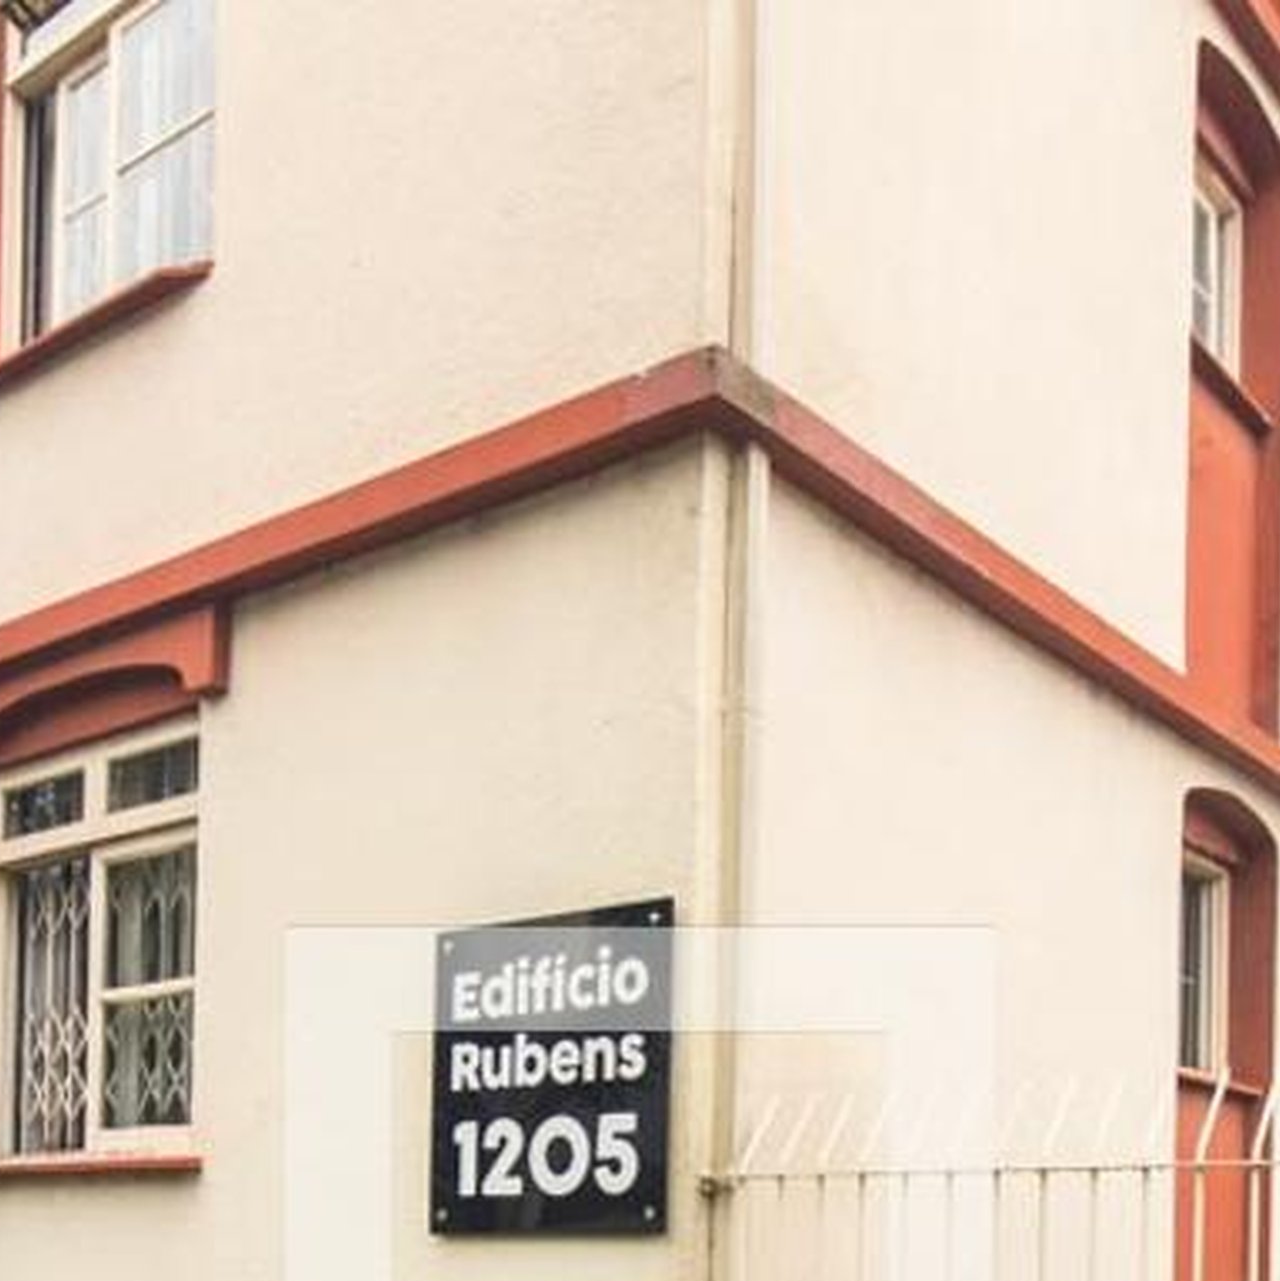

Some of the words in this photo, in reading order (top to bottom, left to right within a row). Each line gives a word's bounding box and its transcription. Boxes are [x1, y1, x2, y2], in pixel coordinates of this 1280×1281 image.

[452, 946, 649, 1022] Edifício
[450, 1033, 646, 1092] Rubens
[452, 1112, 640, 1197] 1205
